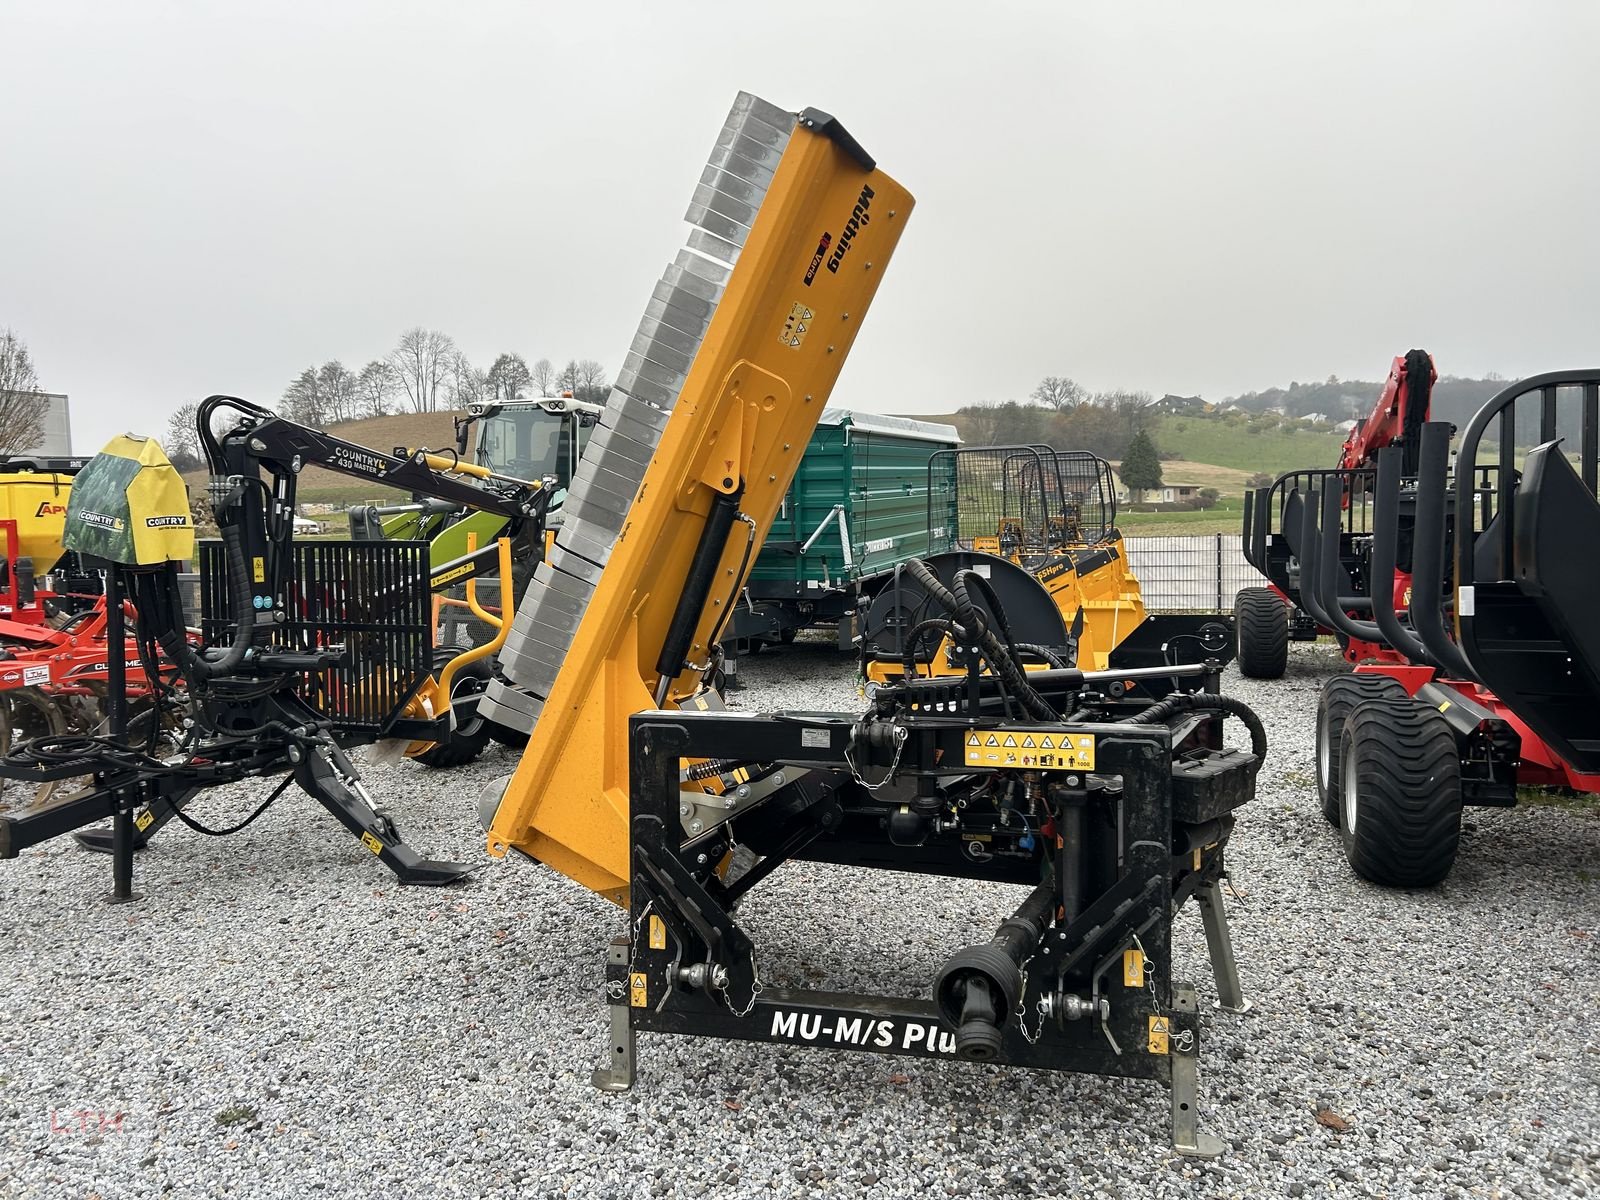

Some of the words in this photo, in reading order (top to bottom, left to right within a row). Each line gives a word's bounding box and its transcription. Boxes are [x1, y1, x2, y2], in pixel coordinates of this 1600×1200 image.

[827, 184, 875, 274] Müthing
[807, 254, 822, 278] Vario
[336, 447, 379, 467] COUNTRY
[338, 458, 352, 468] 430
[354, 461, 377, 473] MASTER
[80, 512, 114, 525] COUNTRY
[771, 1011, 893, 1047] MU-M/S
[902, 1023, 957, 1053] Plu
